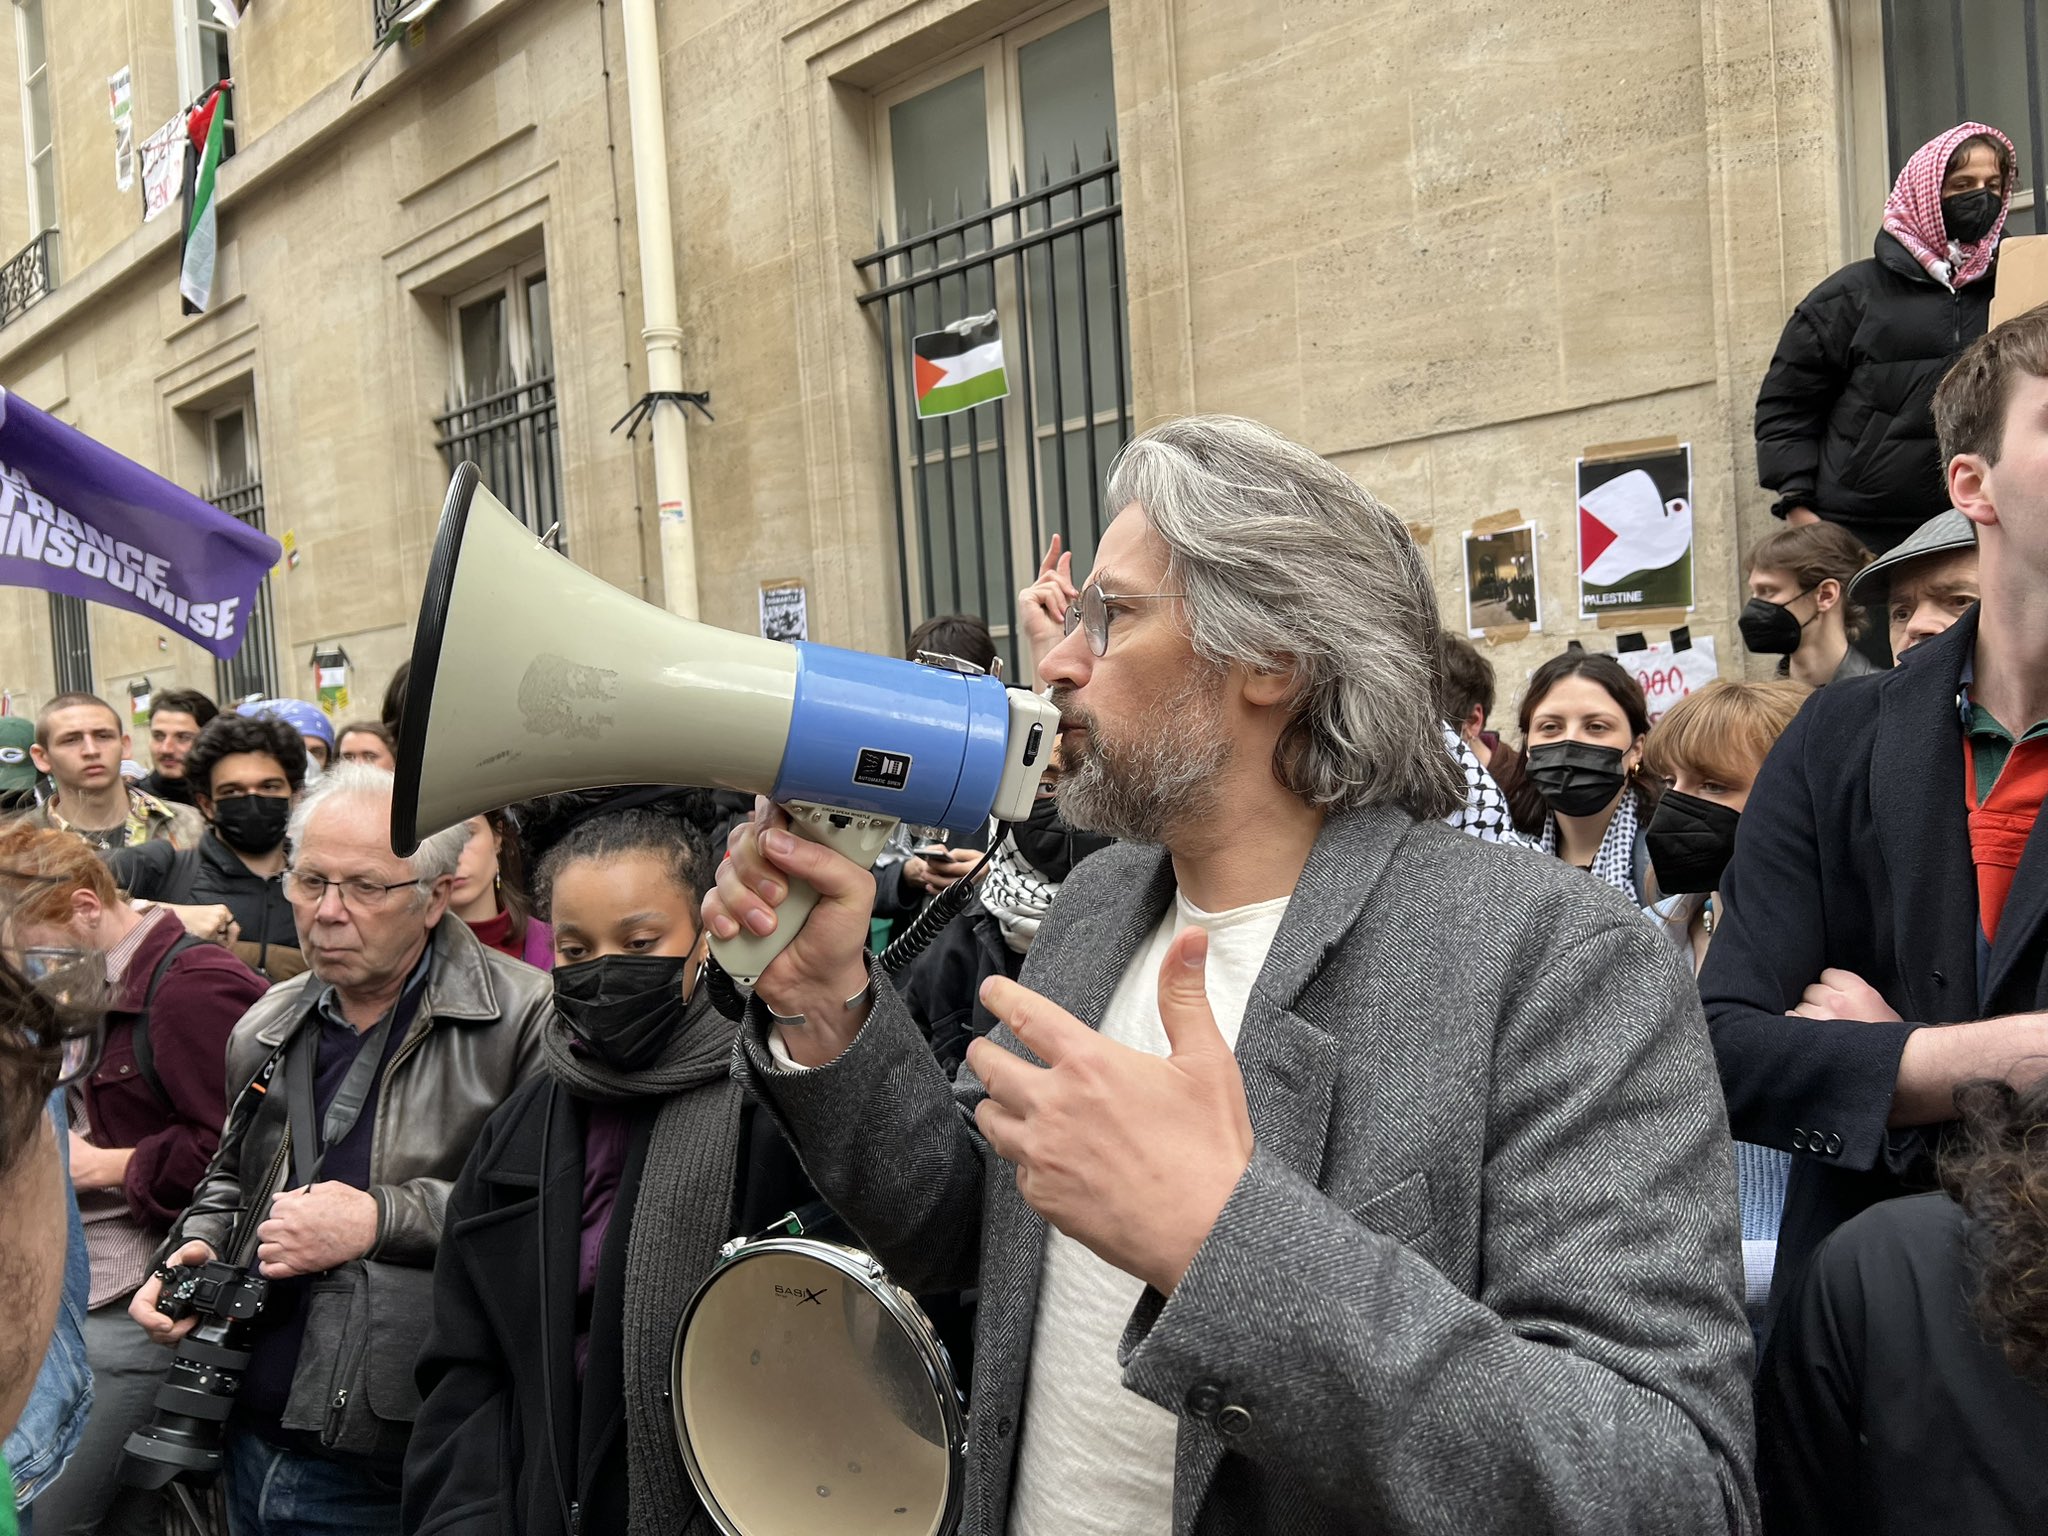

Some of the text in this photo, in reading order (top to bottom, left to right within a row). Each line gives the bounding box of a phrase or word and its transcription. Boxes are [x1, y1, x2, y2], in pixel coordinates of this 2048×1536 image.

[0, 478, 171, 588] FRANCE
[0, 511, 239, 640] INSOUMISE
[1584, 590, 1643, 606] PALESTINE
[858, 775, 886, 784] AUTOMATIC
[774, 1284, 828, 1306] BASIX
